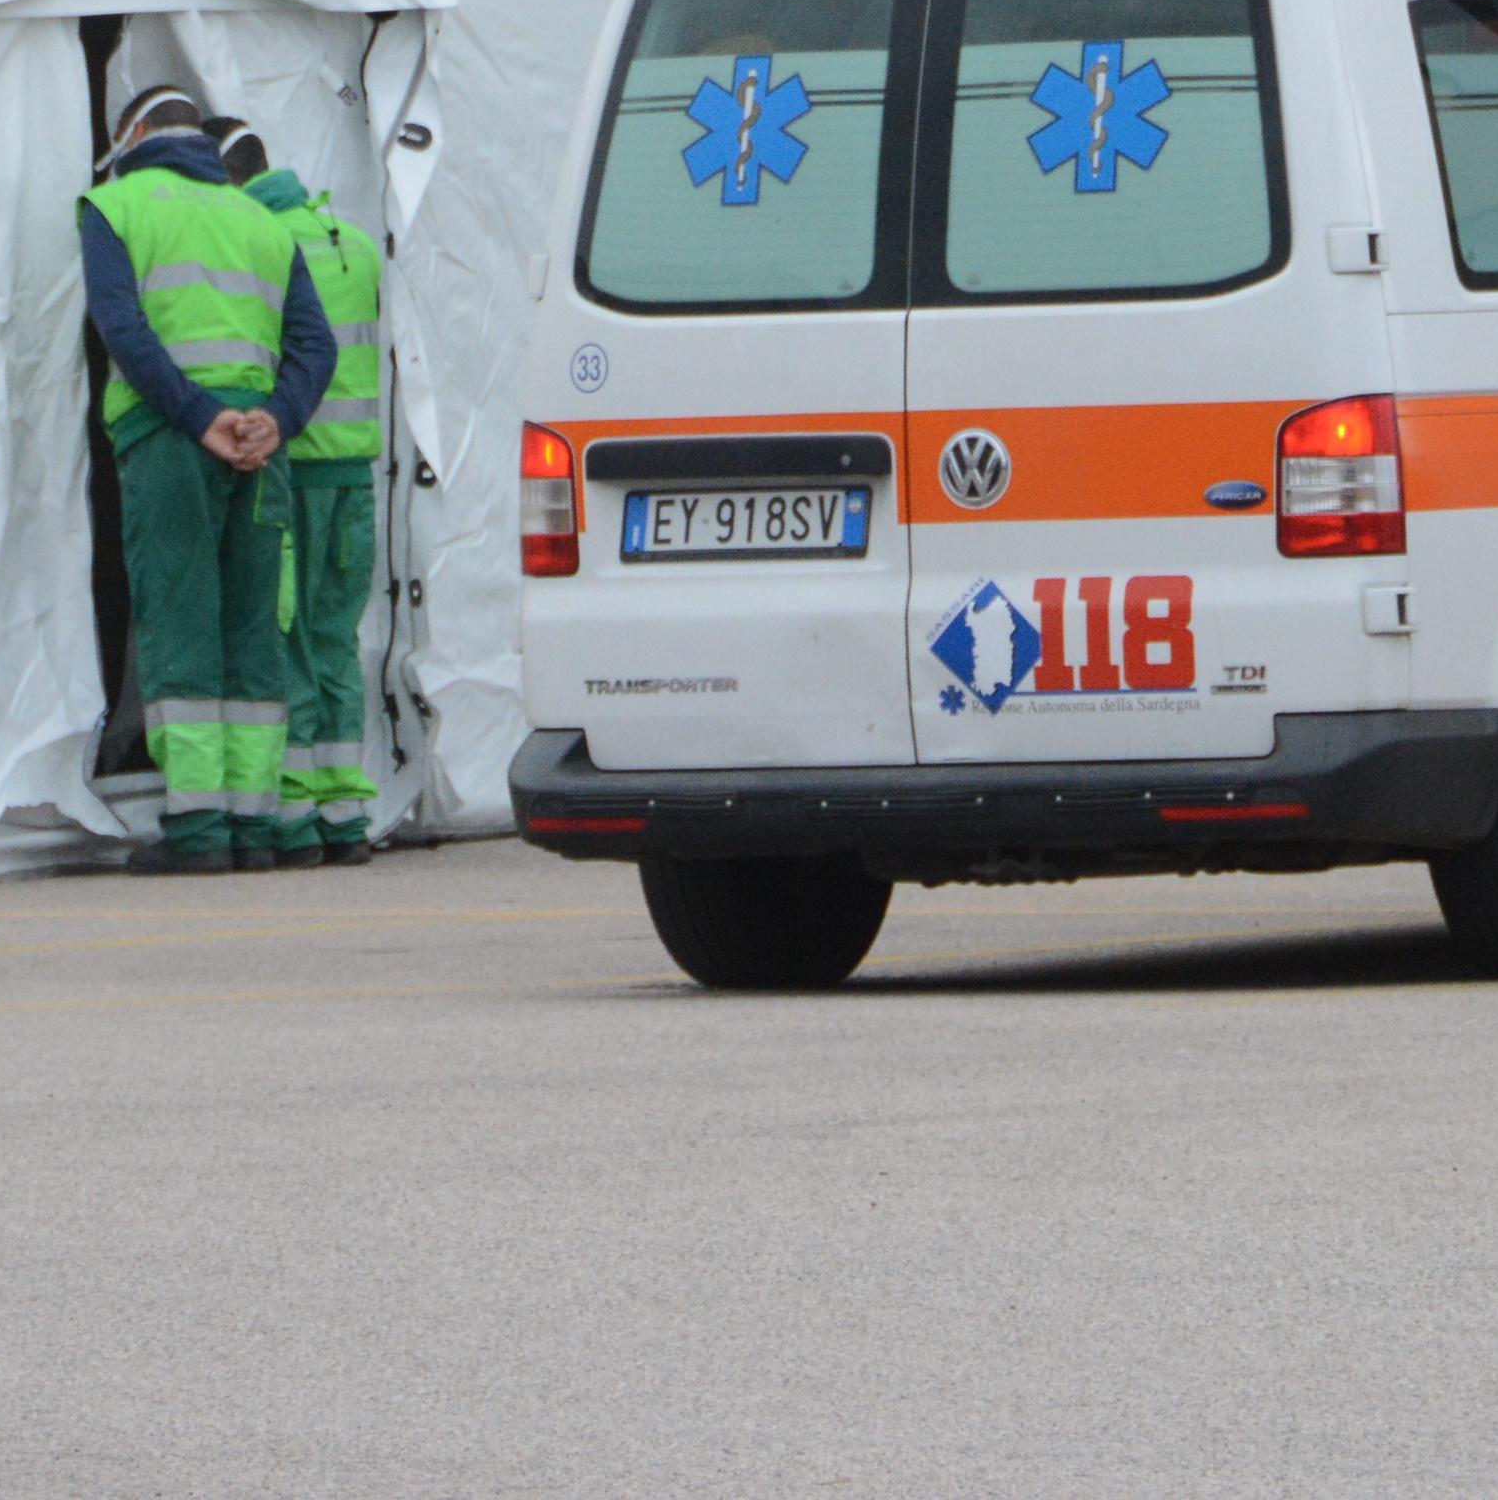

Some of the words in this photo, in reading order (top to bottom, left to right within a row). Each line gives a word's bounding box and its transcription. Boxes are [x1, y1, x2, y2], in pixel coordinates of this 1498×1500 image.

[577, 355, 601, 382] 33
[653, 498, 700, 545] EY
[716, 495, 839, 544] 918SV
[1033, 575, 1196, 692] 118
[1223, 665, 1266, 681] TDI
[584, 677, 739, 695] TRANSPORTER
[1027, 699, 1096, 715] Autonoma
[1100, 697, 1134, 713] della
[1137, 697, 1201, 715] Sardegna
